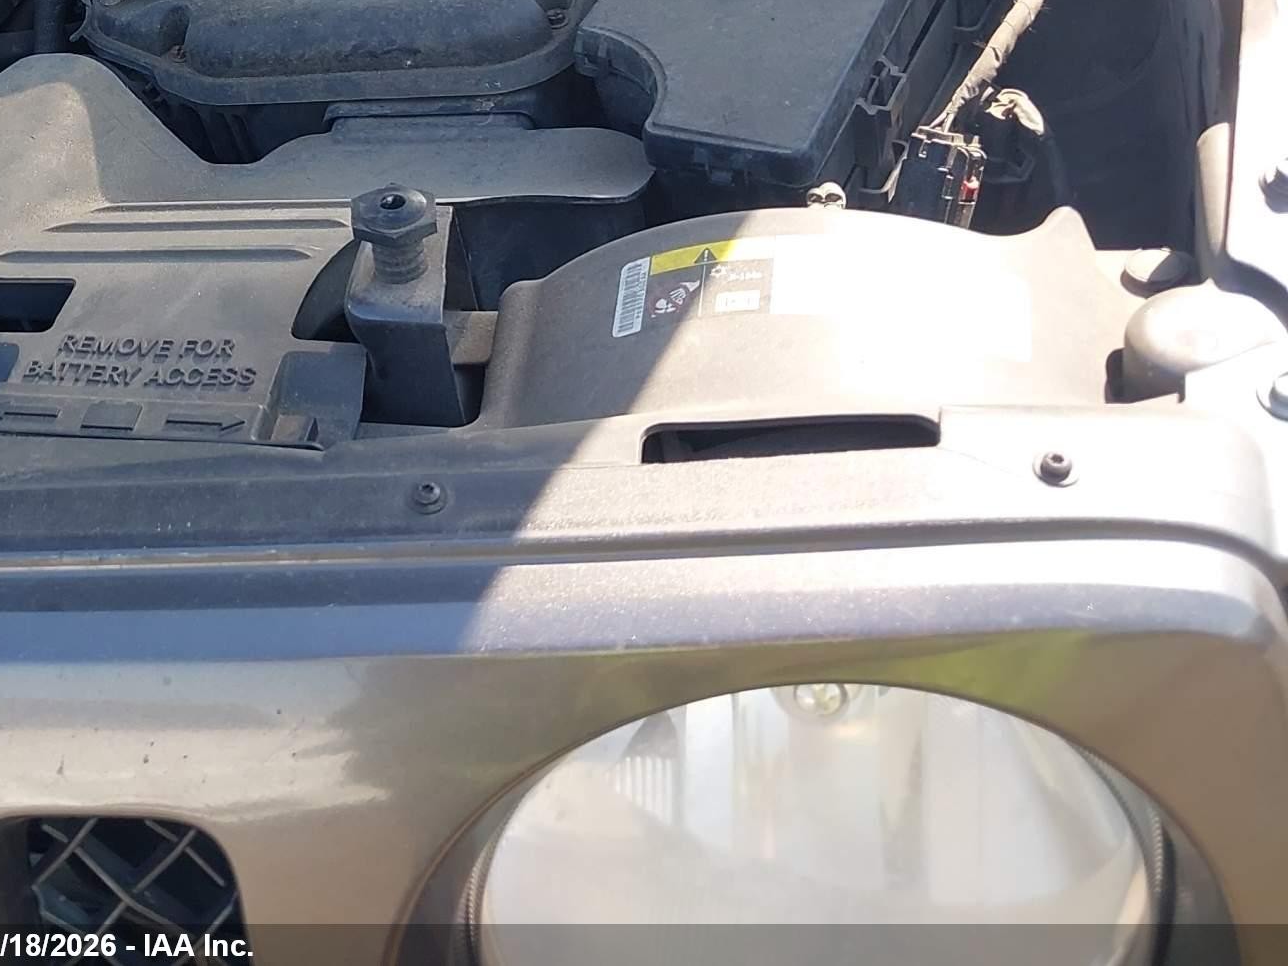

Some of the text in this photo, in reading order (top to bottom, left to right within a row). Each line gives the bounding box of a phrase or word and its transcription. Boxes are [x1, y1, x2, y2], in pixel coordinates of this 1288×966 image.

[57, 334, 236, 362] REMOVE FOR
[23, 359, 257, 390] BATTERY ACCESS
